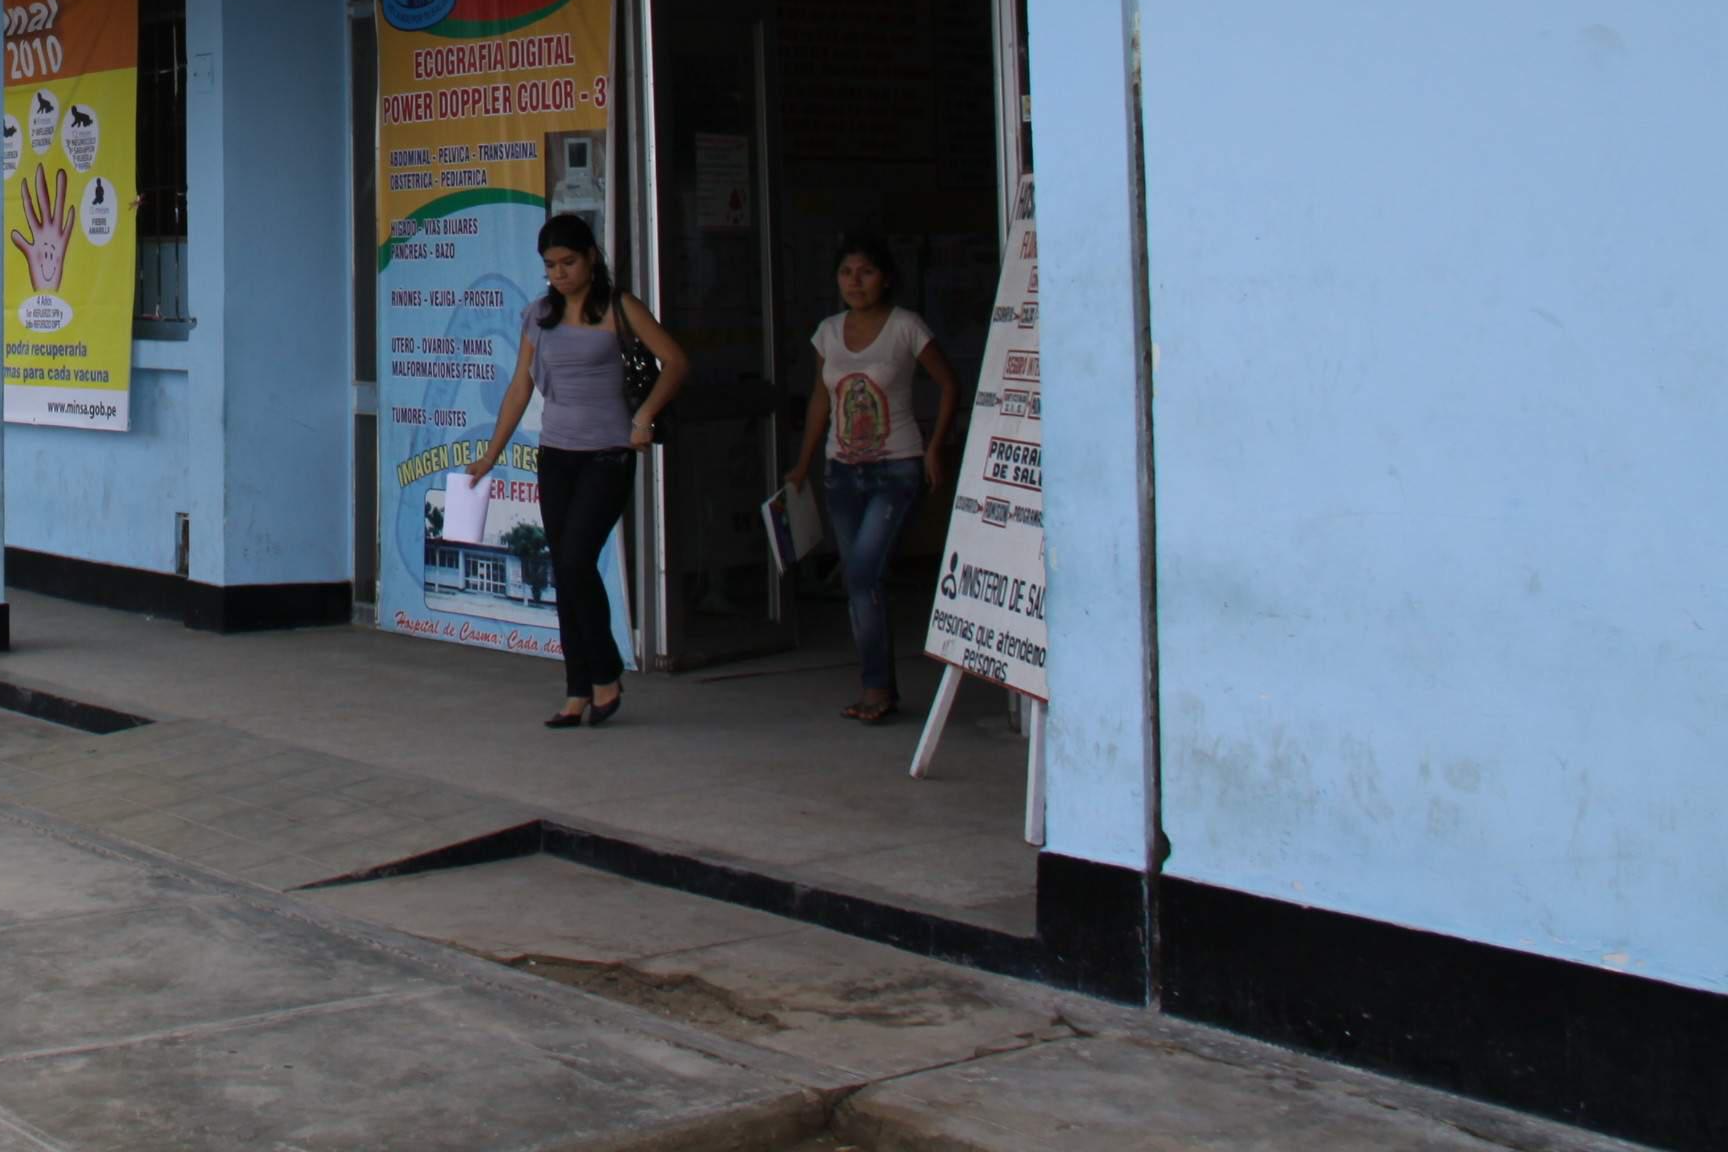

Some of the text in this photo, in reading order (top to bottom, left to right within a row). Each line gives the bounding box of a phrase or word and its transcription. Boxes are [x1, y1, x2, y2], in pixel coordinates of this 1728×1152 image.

[6, 35, 62, 79] 2010
[414, 33, 574, 80] ECOGRAFIA DIGITAL
[383, 91, 433, 124] POWER
[439, 82, 512, 119] DOPPLER
[517, 78, 574, 113] COLOR
[389, 149, 432, 168] ABDOMINAL
[439, 145, 470, 164] PELVICA
[478, 141, 538, 162] TRANSVAGINAL
[390, 172, 432, 191] OBSTETRICA
[440, 169, 487, 187] PEDIATRICA
[390, 219, 417, 236] HIGADO
[424, 218, 440, 236] VIAS
[443, 218, 478, 235] BILIARES
[390, 243, 427, 260] PANCREAS
[435, 242, 455, 259] BAZO
[391, 288, 421, 307] RIÑONES
[429, 290, 455, 307] VEJIGA
[464, 290, 504, 307] PROSTATA
[391, 337, 414, 354] UTERO
[422, 338, 455, 355] OVARIOS
[463, 339, 492, 356] MAMAS
[23, 367, 45, 383] para
[47, 364, 70, 381] cada
[73, 368, 110, 383] vacuna
[392, 360, 495, 381] MALFORMACIONES FETALES
[47, 400, 116, 419] www.minsa.gob.pe
[392, 407, 426, 425] TUMORES
[434, 409, 467, 428] QUISTES
[397, 443, 449, 488] IMAGEN
[452, 441, 471, 466] DE
[993, 462, 1009, 480] DE
[959, 563, 1008, 608] MINISTERIO
[1009, 578, 1026, 613] DE
[395, 611, 440, 635] Hospital
[443, 622, 456, 636] de
[507, 630, 538, 652] Cada
[976, 625, 994, 650] que
